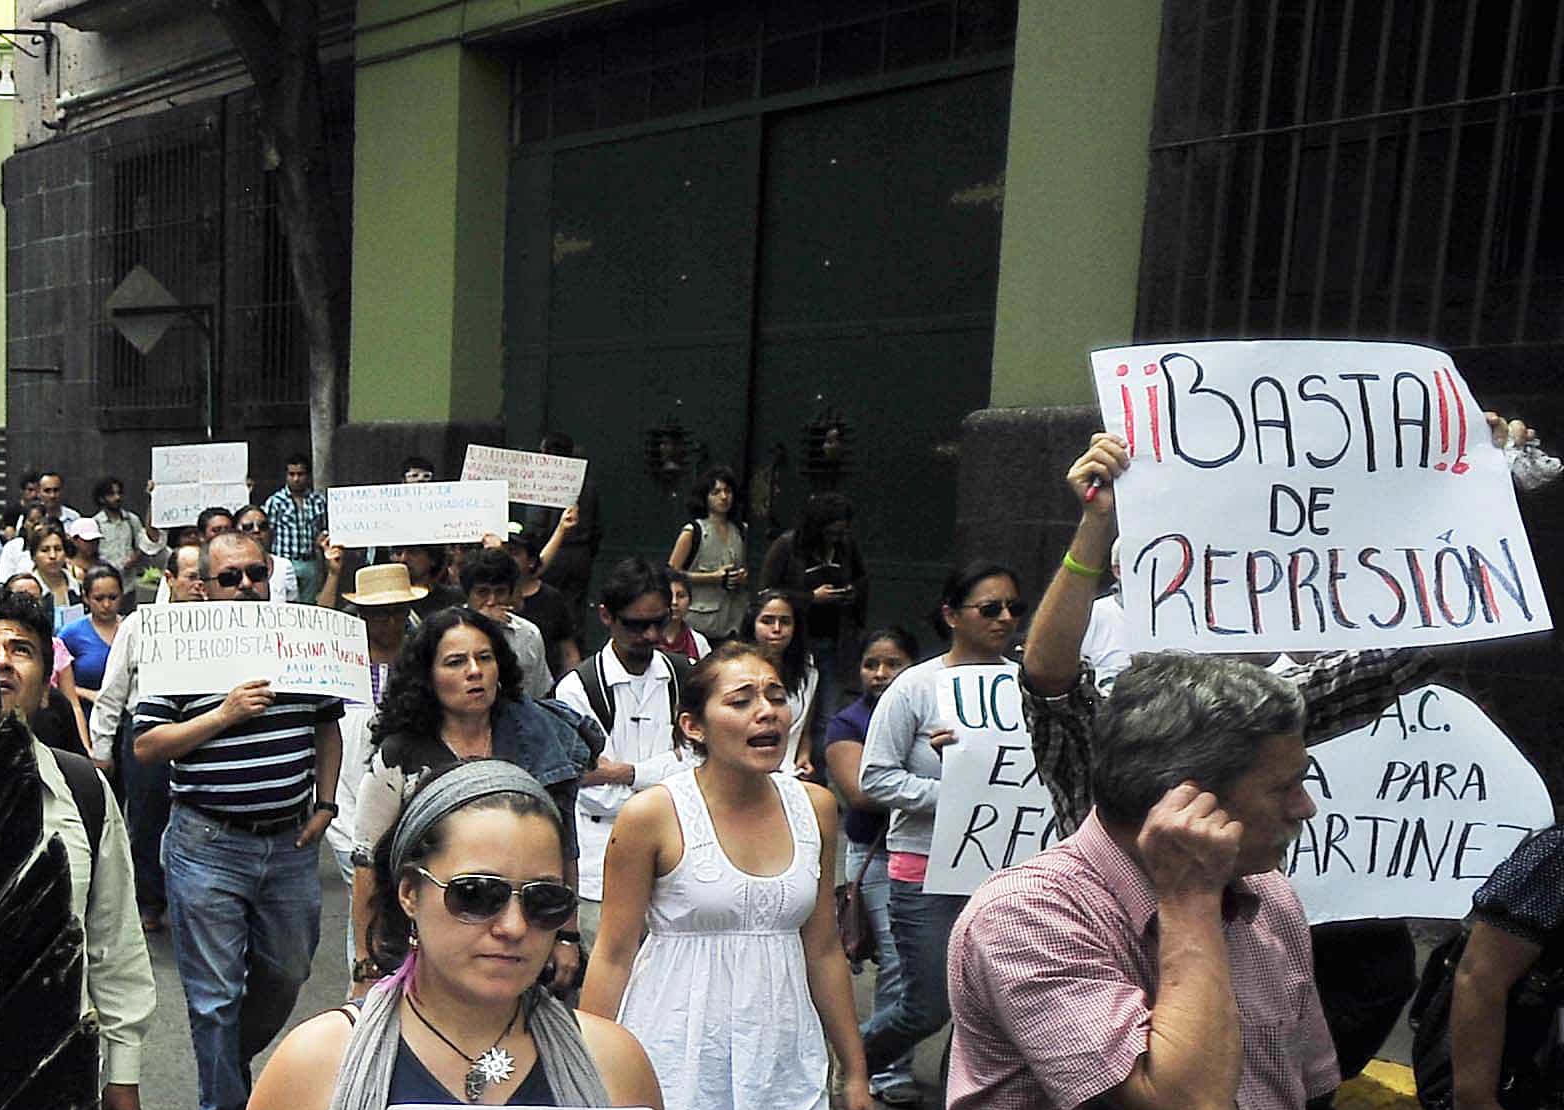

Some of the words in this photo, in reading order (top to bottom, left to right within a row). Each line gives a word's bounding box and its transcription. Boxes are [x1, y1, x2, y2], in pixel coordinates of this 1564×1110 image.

[1269, 484, 1334, 536] DE
[1133, 528, 1533, 638] REPRESIÓN
[140, 607, 223, 636] REPUDIO
[229, 605, 249, 629] AL
[256, 604, 340, 636] ASESINATO
[343, 616, 361, 638] DE
[139, 638, 164, 665] LA
[175, 633, 275, 662] PERIODISTA
[276, 631, 328, 660] REGINA
[1376, 760, 1487, 802] PARA
[1286, 813, 1533, 881] ARTINEZ
